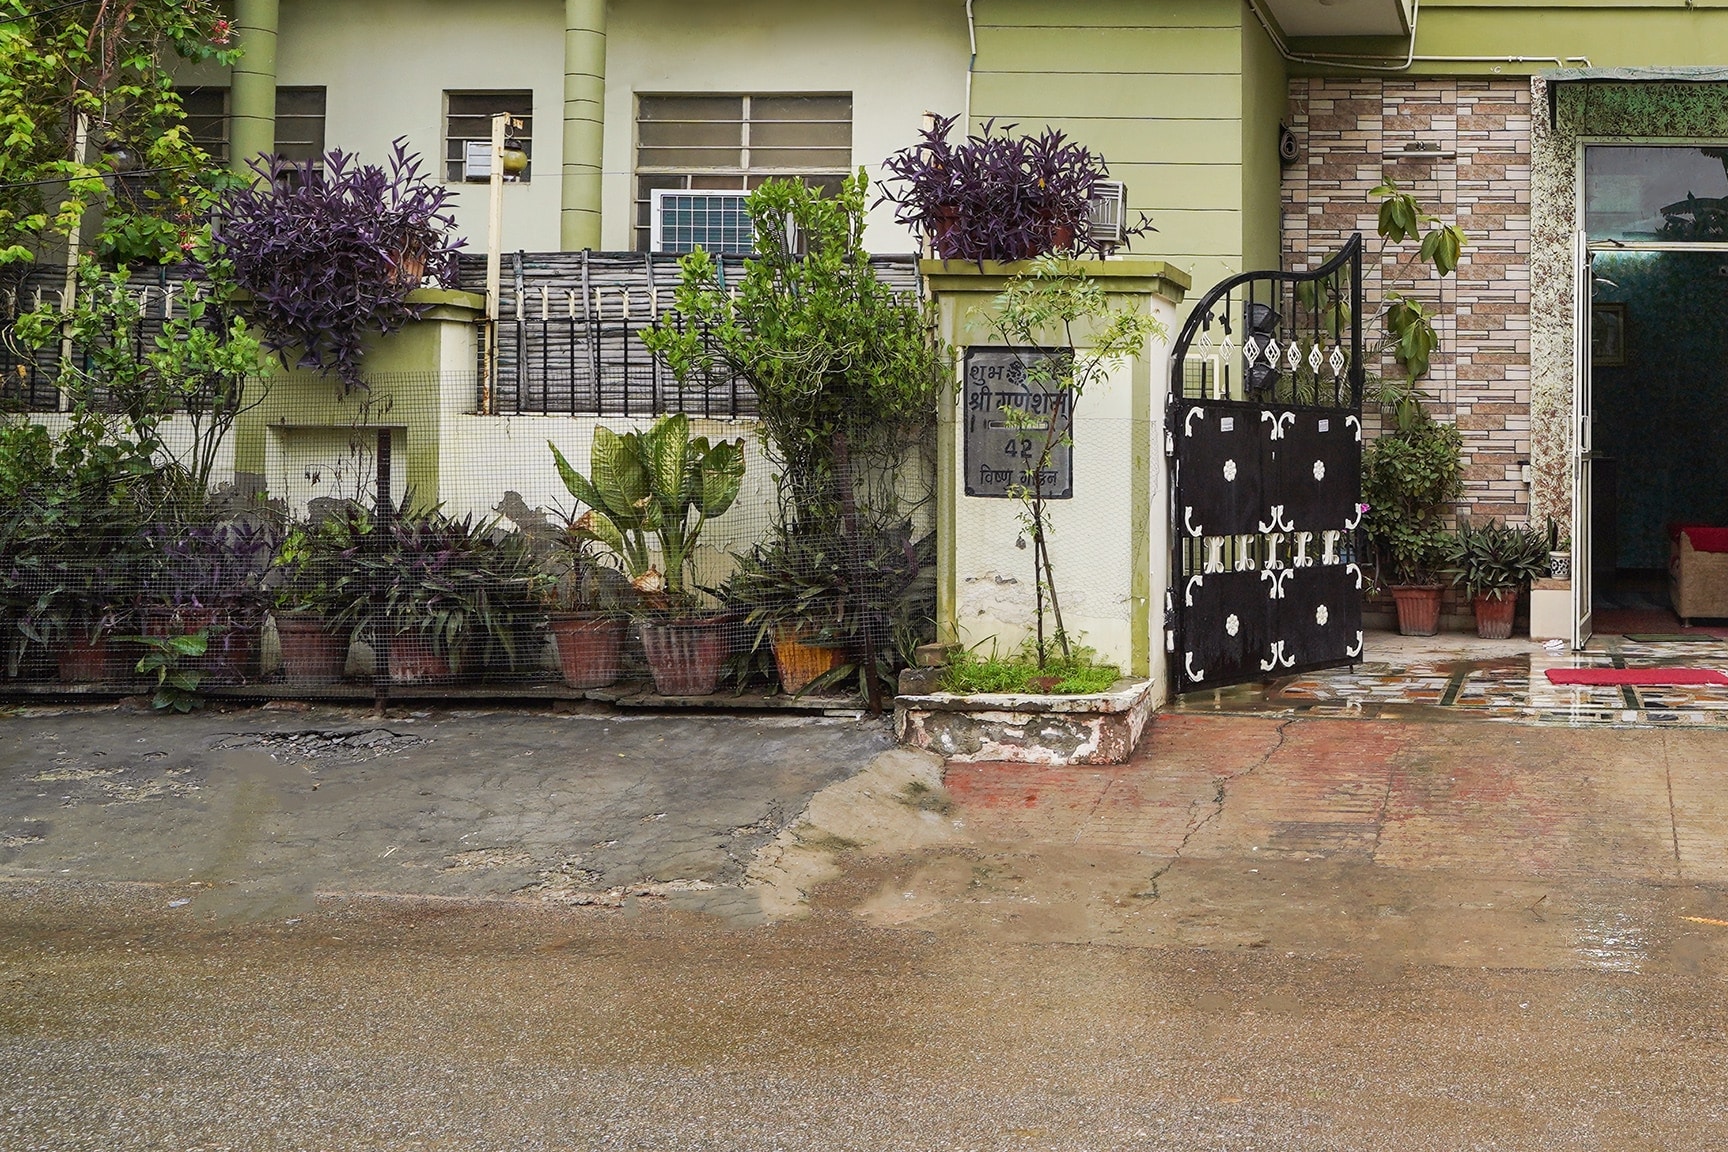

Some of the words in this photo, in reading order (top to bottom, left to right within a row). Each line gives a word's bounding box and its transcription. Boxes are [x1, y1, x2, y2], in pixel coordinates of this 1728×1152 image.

[969, 365, 1004, 386] शुभ
[969, 386, 992, 412] श्री
[1004, 439, 1032, 458] 42
